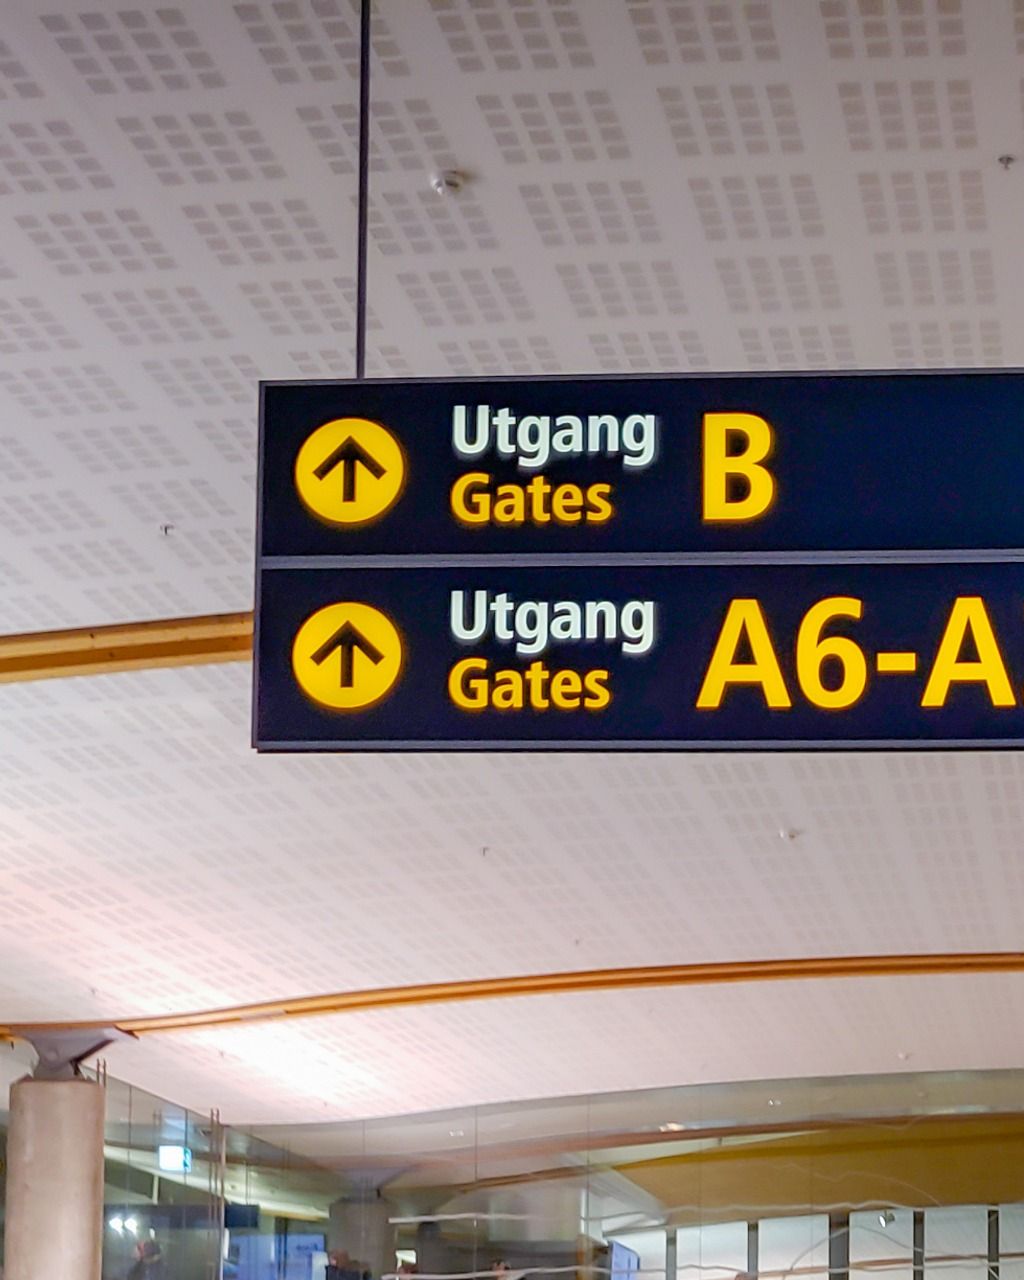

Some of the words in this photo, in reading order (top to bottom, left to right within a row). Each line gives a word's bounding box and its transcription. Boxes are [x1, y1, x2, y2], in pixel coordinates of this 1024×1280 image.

[453, 405, 655, 467] Utgang
[704, 414, 773, 519] B
[451, 471, 613, 524] Gates
[451, 591, 654, 654] Utgang
[448, 656, 611, 710] Gates
